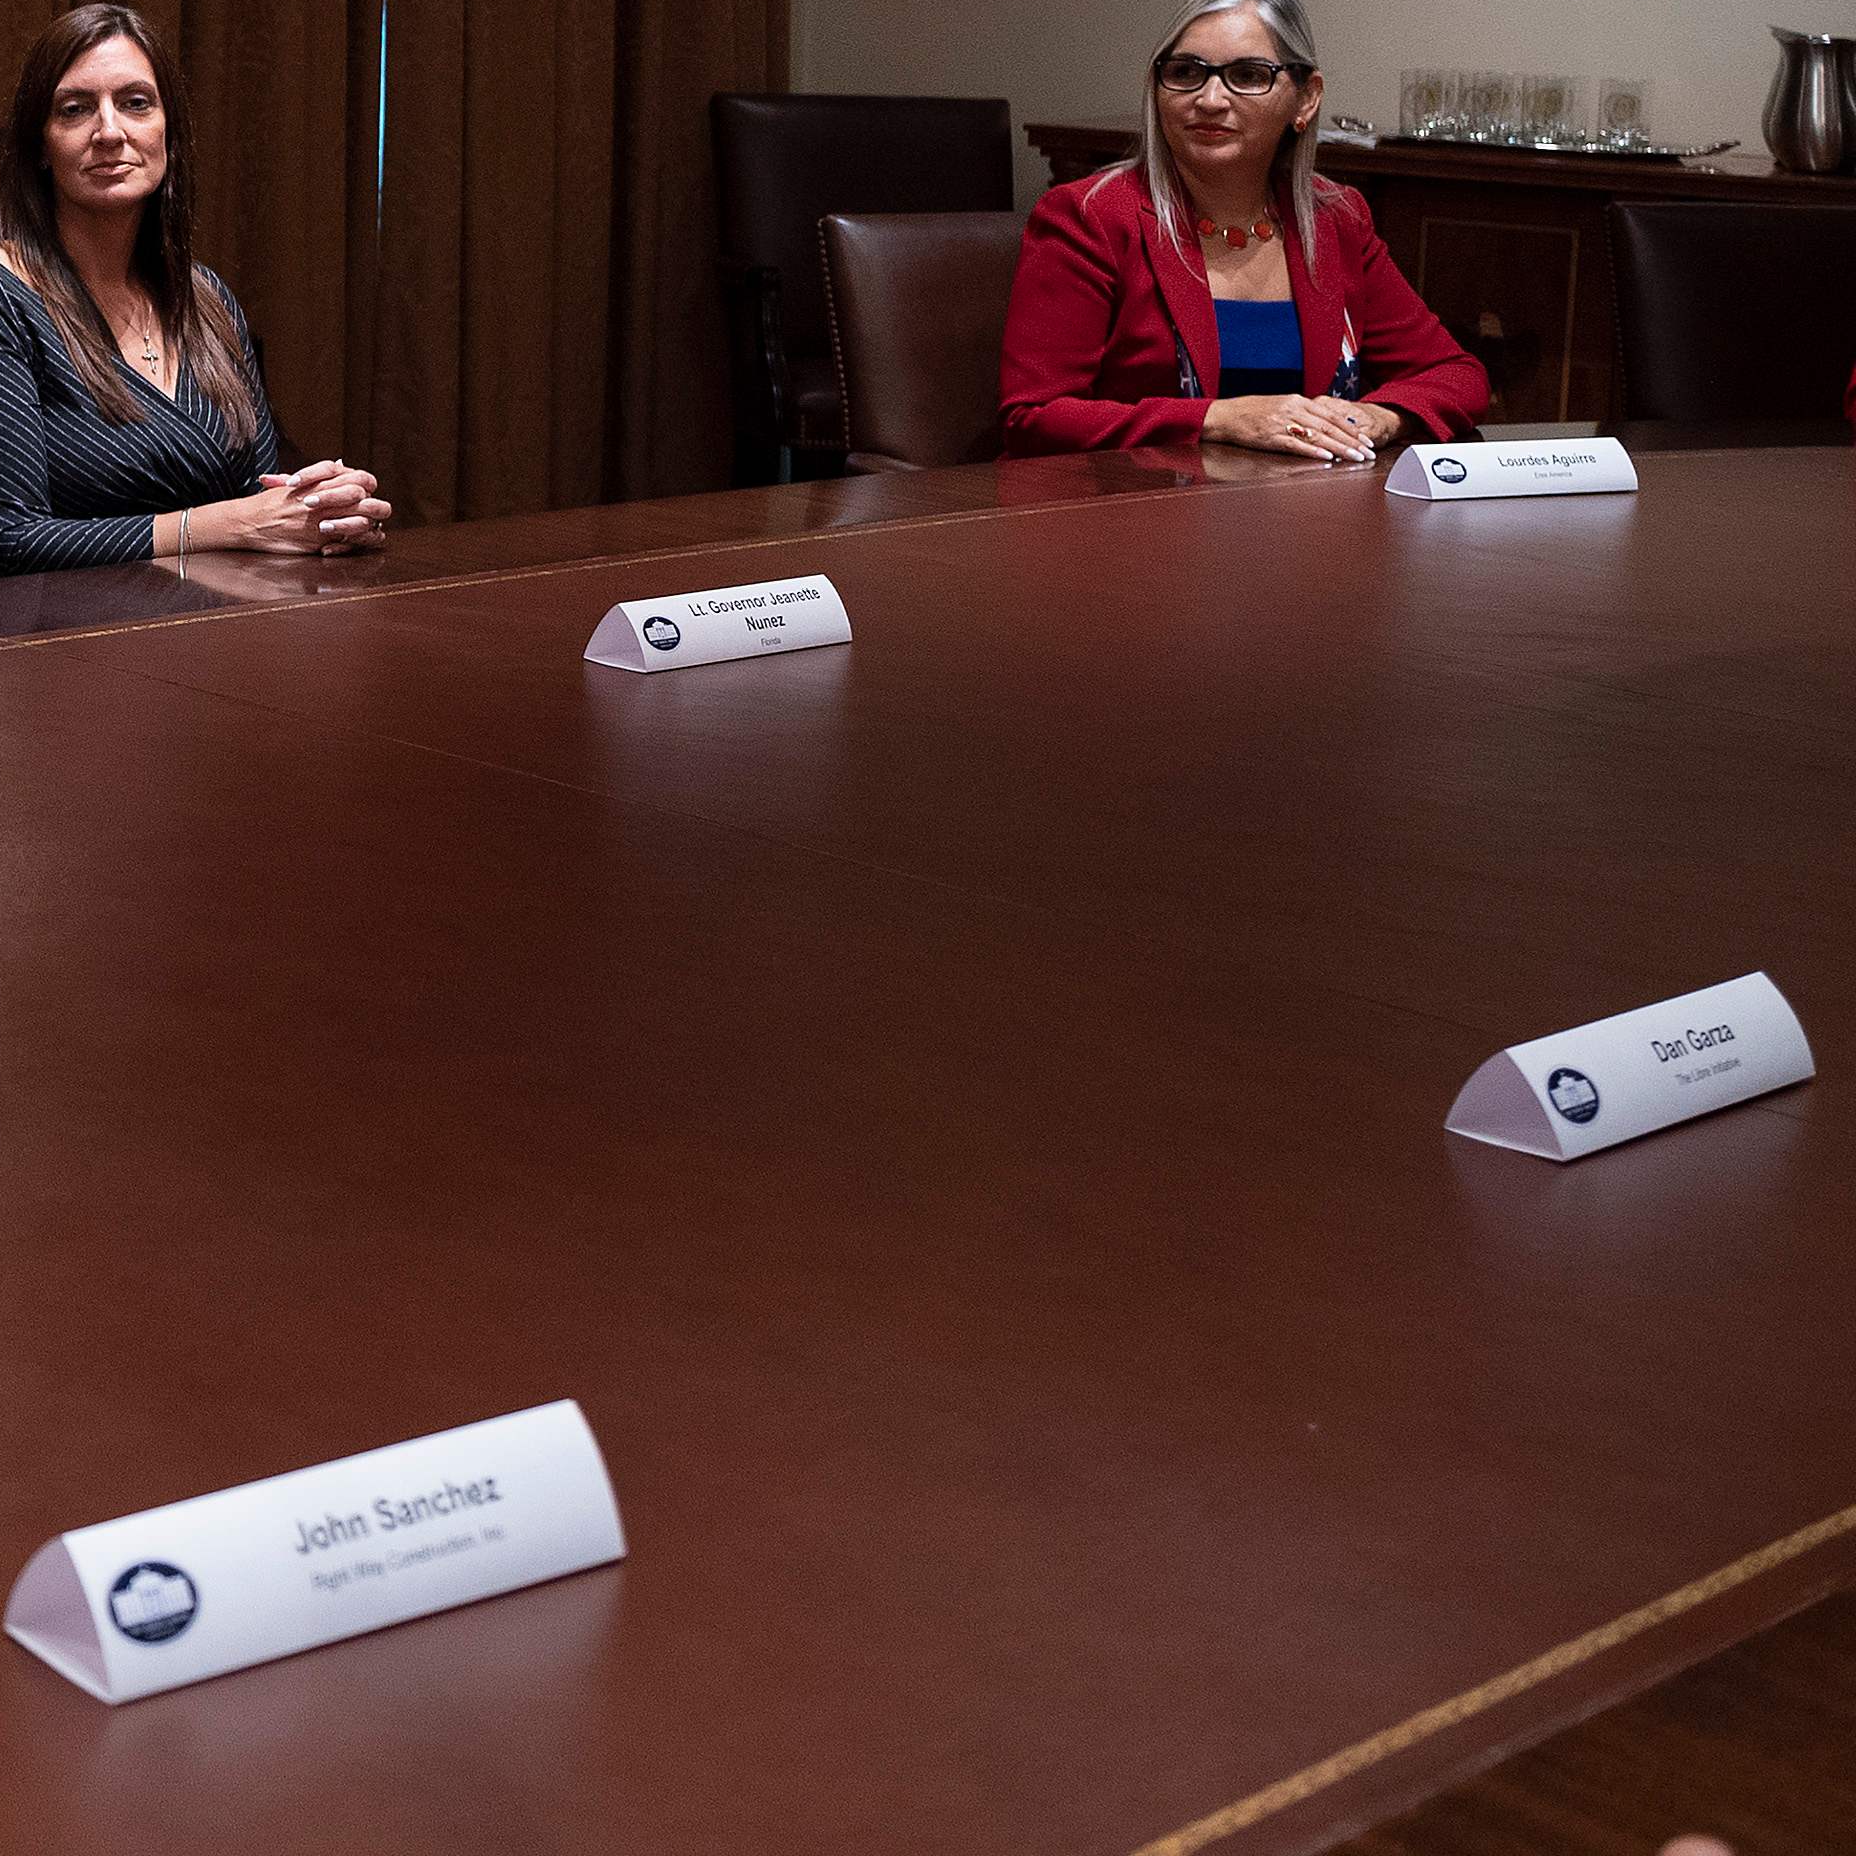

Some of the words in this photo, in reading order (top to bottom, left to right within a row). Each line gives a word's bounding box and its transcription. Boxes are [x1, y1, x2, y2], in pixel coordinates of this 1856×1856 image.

[1497, 454, 1549, 468] Lourdes
[1552, 453, 1597, 468] Aguirre
[688, 603, 709, 617] Lt.
[708, 596, 767, 614] Governor
[770, 587, 821, 606] Jeanette
[745, 615, 786, 631] Nunez
[1651, 1039, 1689, 1062] Dan
[1686, 1024, 1735, 1051] Garza
[296, 1512, 370, 1555] John
[373, 1478, 504, 1531] Sanchez
